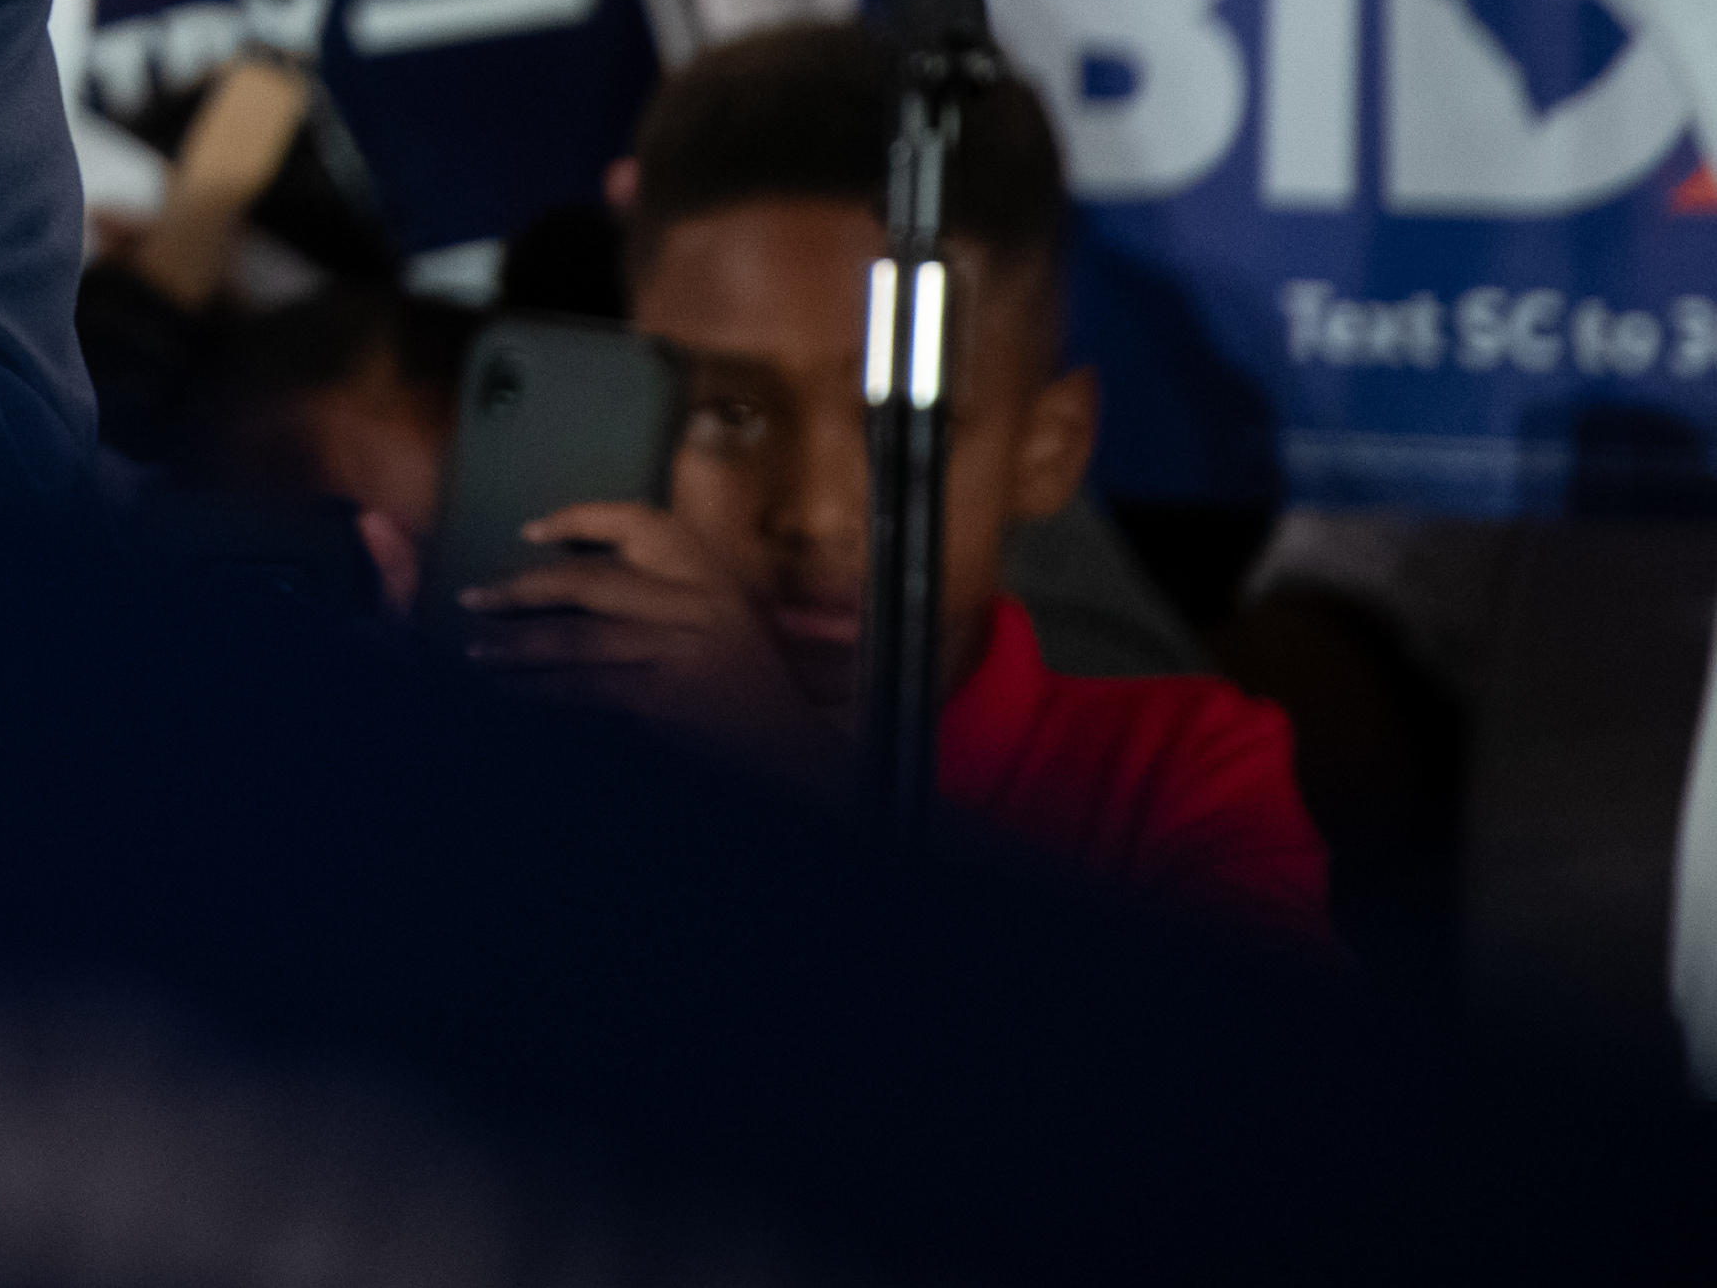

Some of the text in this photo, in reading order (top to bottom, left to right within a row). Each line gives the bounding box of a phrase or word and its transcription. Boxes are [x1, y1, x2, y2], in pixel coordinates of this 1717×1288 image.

[1279, 277, 1443, 371] Text
[1453, 284, 1567, 374] SC
[1572, 294, 1662, 378] to
